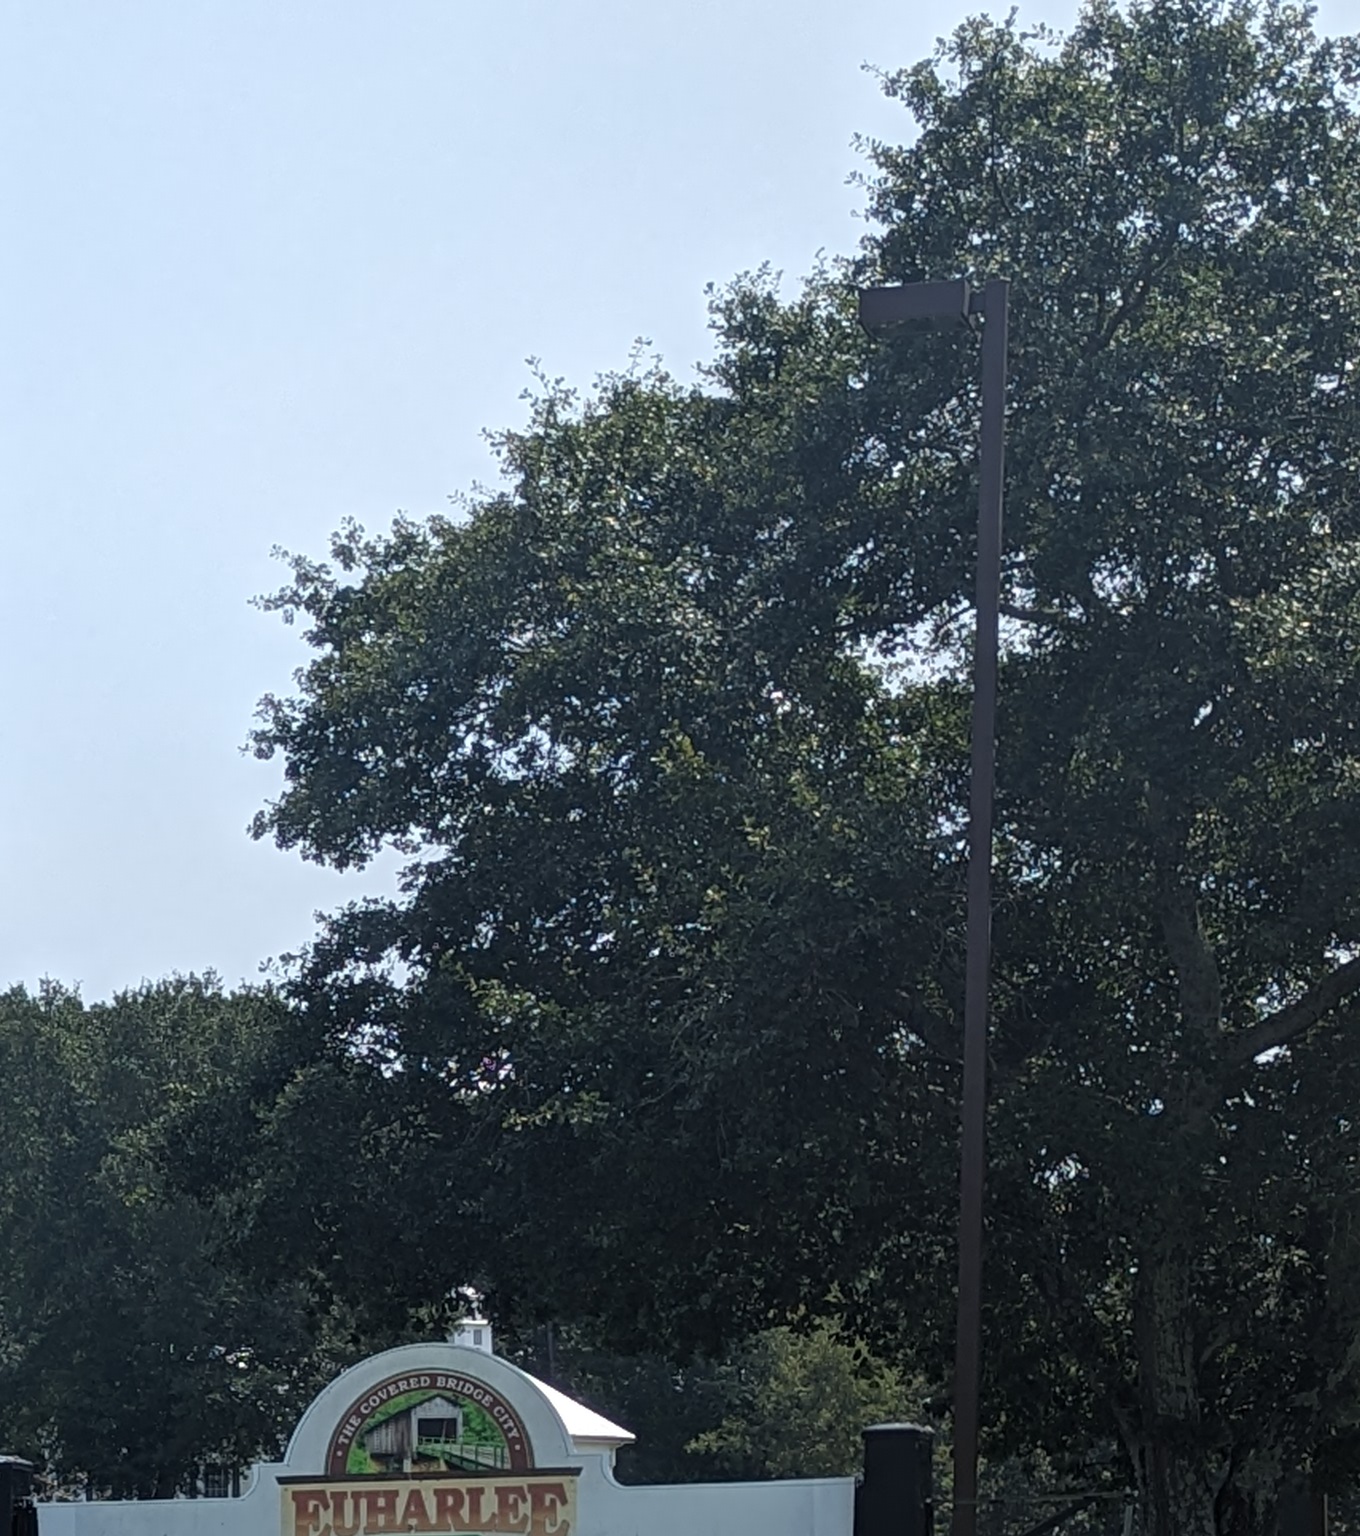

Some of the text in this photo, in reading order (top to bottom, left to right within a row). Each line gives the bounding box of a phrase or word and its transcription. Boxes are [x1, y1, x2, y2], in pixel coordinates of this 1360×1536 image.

[338, 1375, 521, 1446] THE COVERED BRIDGE CITY
